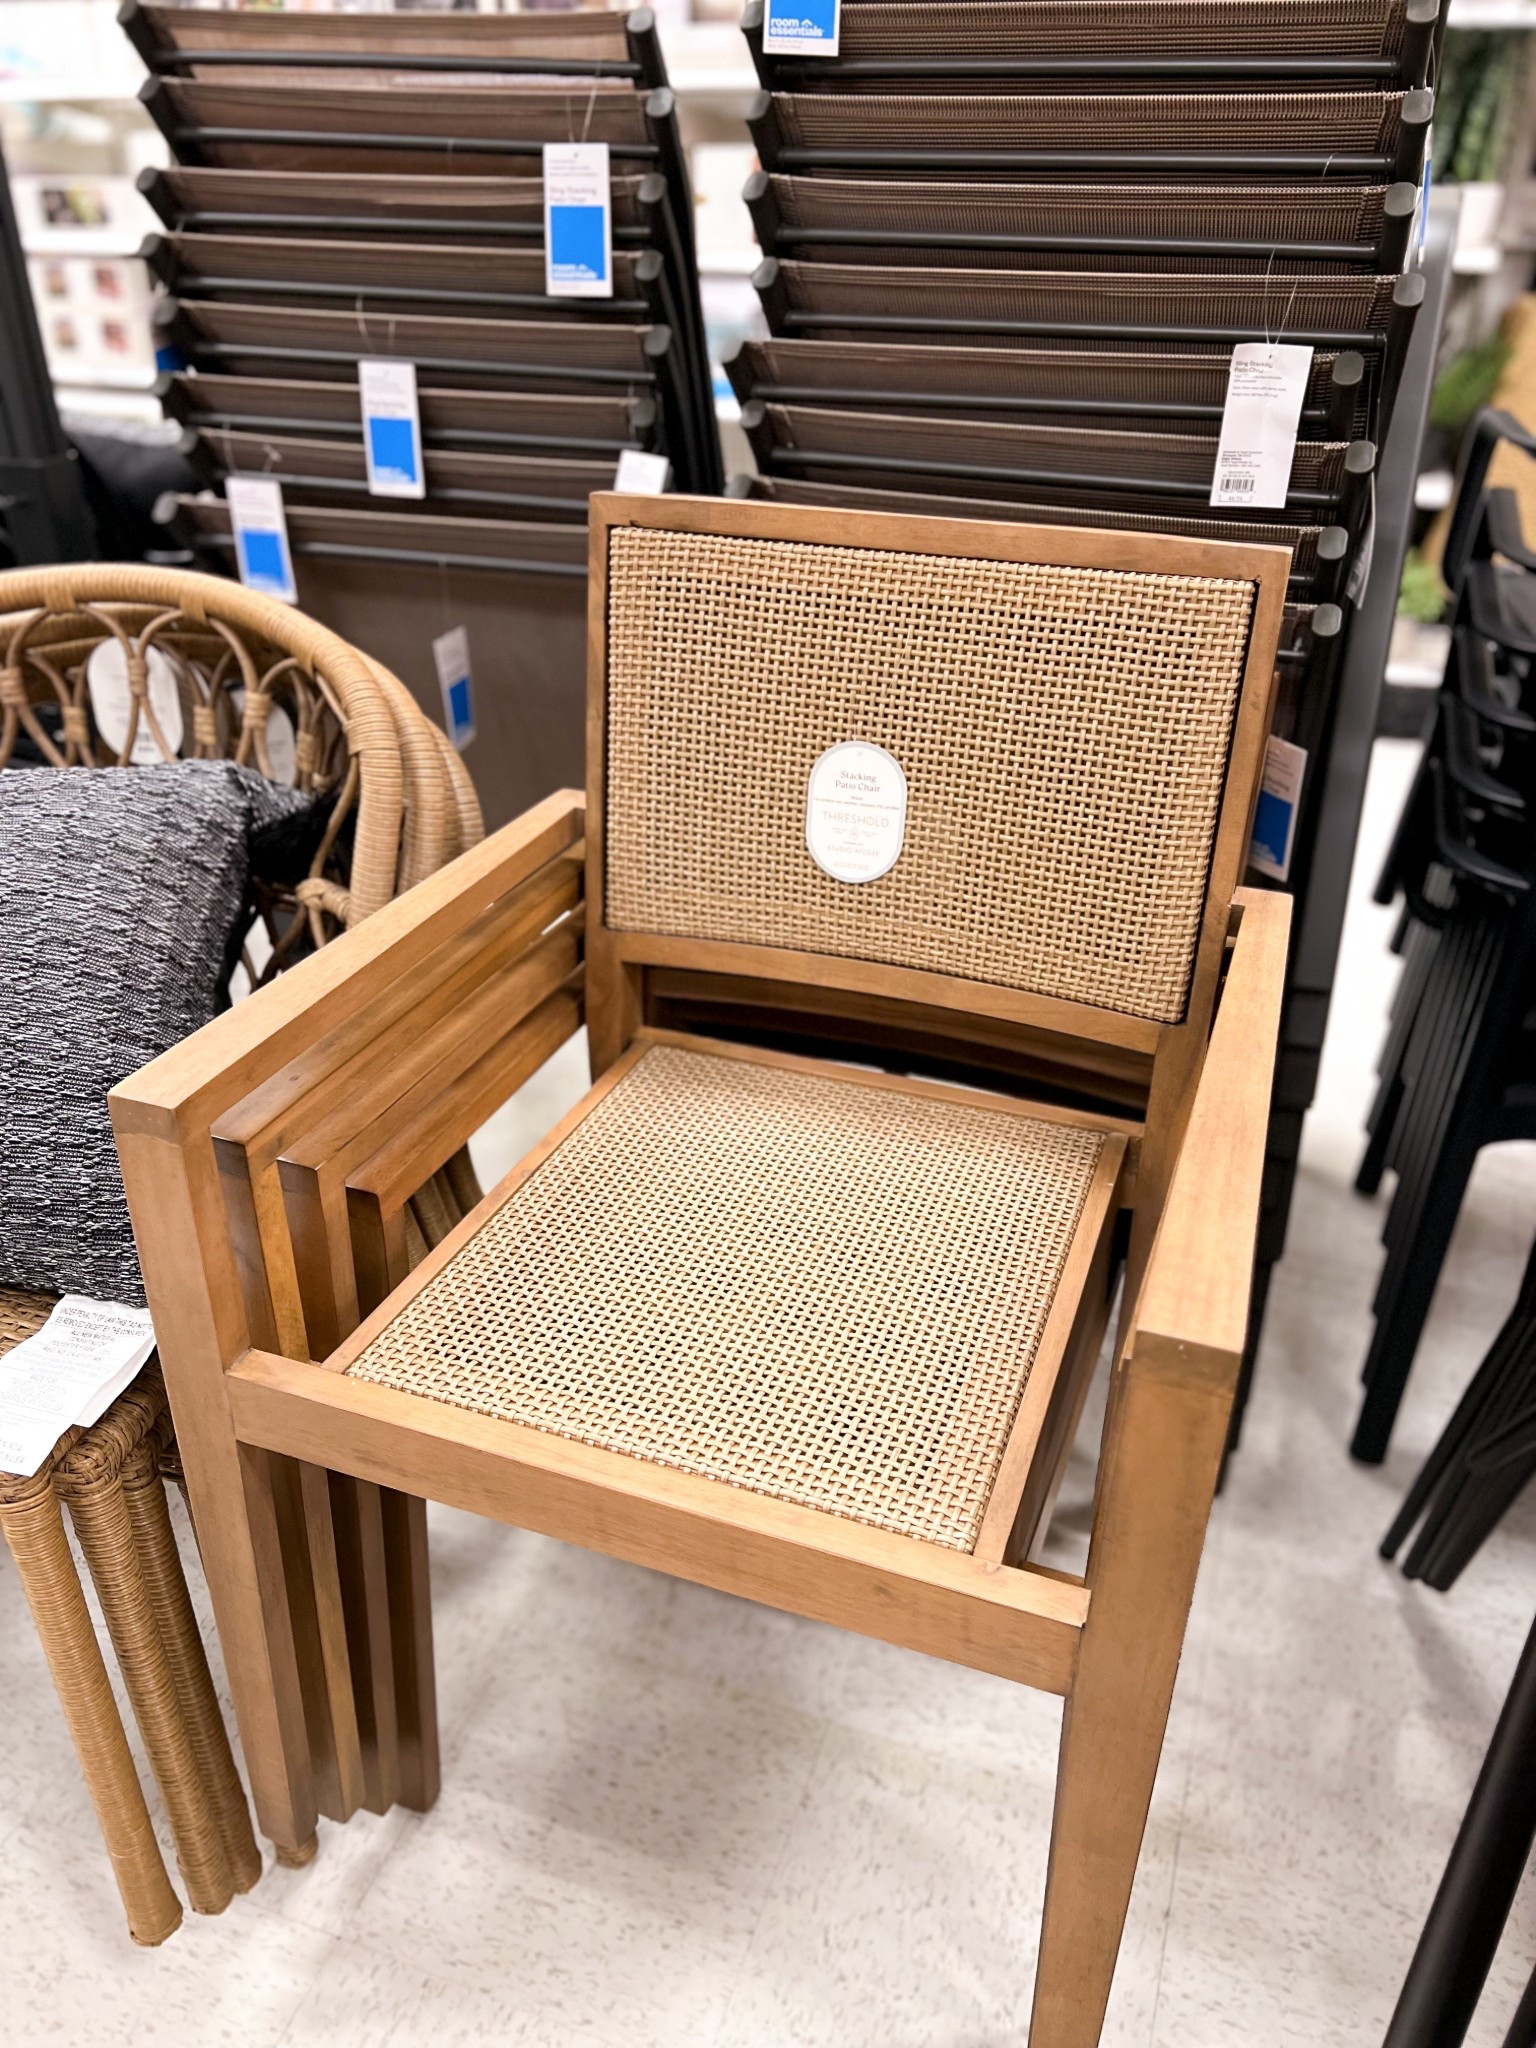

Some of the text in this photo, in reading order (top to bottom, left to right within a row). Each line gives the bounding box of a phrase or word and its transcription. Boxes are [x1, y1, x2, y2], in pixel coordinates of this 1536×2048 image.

[771, 17, 799, 27] room
[770, 25, 823, 37] essentials
[840, 770, 877, 783] Stacking
[835, 780, 880, 792] Patio Chair
[822, 810, 890, 827] THRESHOLD
